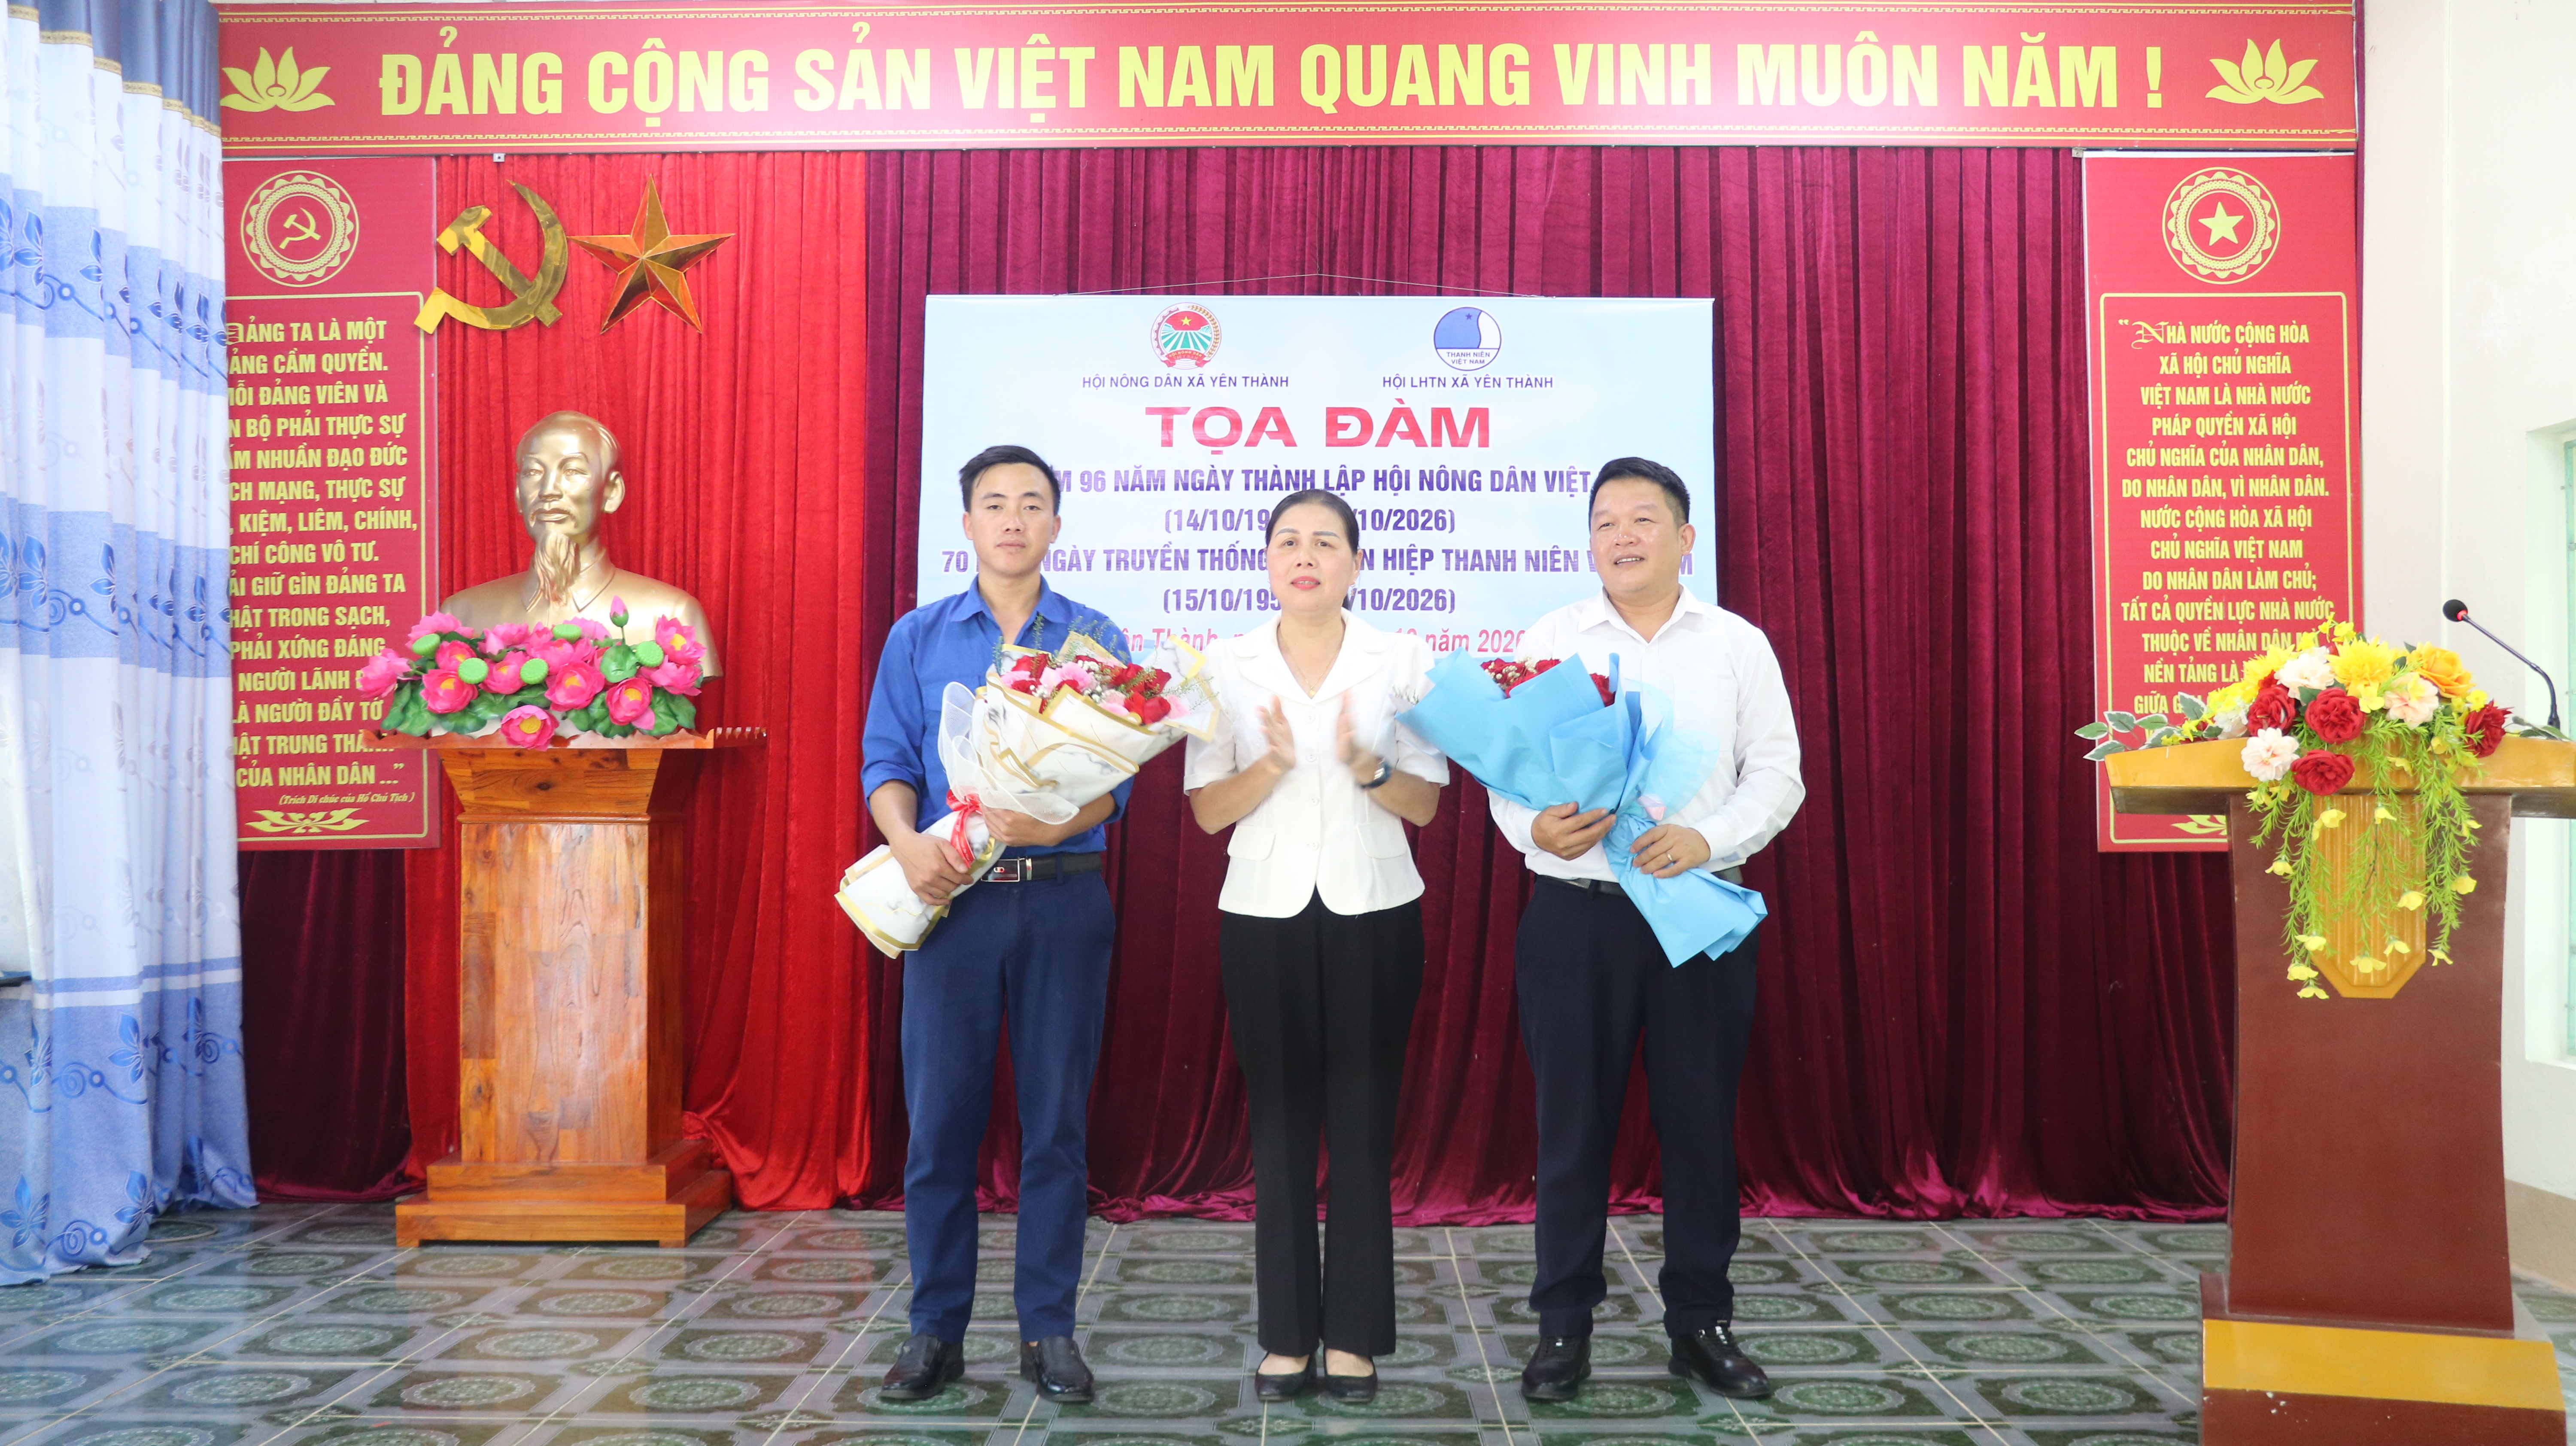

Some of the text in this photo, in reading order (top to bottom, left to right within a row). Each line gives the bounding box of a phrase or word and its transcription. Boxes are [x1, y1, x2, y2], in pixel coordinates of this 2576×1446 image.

[378, 22, 2163, 127] ĐẢNG CỘNG SẢN VIỆT NAM QUANG VINH MUÔN NĂM !
[289, 316, 387, 344] TA LÀ MỘT
[2190, 319, 2310, 348] NƯỚC CỘNG HÒA
[273, 345, 388, 374] CẦM QUYỀN.
[2159, 347, 2292, 378] XÃ HỘI CHỦ NGHĨA
[258, 378, 388, 405] ĐẢNG VIÊN VÀ
[1083, 373, 1288, 391] HỘI NÔNG DÂN XÃ YÊN THÀNH
[1383, 373, 1553, 390] HỘI LHTN XÃ YÊN THÀNH
[2140, 380, 2311, 409] VIỆT NAM LÀ NHÀ NƯỚC
[246, 414, 271, 441] BỘ
[276, 409, 320, 437] PHẢI
[325, 414, 374, 439] THỰC
[379, 413, 407, 438] SỰ
[1145, 398, 1489, 455] TỌA ĐÀM
[2152, 410, 2297, 439] PHÁP QUYỀN XÃ HỘI
[256, 442, 322, 469] NHUẦN
[326, 447, 365, 471] ĐẠO
[369, 441, 407, 466] ĐỨC
[2126, 440, 2324, 468] CHỦ NGHĨA CỦA NHÂN DÂN,
[258, 476, 407, 504] MẠNG, THỰC SỰ
[1080, 470, 1106, 492] 96
[1114, 465, 1166, 492] NĂM
[1174, 464, 1234, 492] NGÀY
[1242, 464, 1315, 491] THÀNH
[1324, 465, 1365, 496] LẬP
[1373, 464, 1410, 496] HỘI
[1419, 464, 1482, 492] NÔNG
[1490, 465, 1536, 492] DÂN
[1543, 466, 1591, 498] VIỆT
[2122, 474, 2330, 499] DO NHÂN DÂN, VÌ NHÂN DÂN.
[240, 509, 292, 536] KIỆM,
[298, 507, 349, 532] LIÊM,
[354, 506, 417, 531] CHÍNH,
[1165, 509, 1273, 534] (14/10/19
[2140, 504, 2312, 532] NƯỚC CỘNG HÒA XÃ HỘI
[229, 539, 379, 565] CHÍ CÔNG VÔ TƯ.
[942, 550, 968, 572] 70
[1103, 541, 1189, 571] TRUYỀN
[1197, 541, 1268, 571] THỐNG
[1383, 543, 1434, 576] HIỆP
[1441, 549, 1516, 572] THANH
[1525, 545, 1579, 572] NIÊN
[2151, 532, 2303, 563] CHỦ NGHĨA VIỆT NAM
[252, 566, 406, 596] GIỮ GÌN ĐẢNG TA
[2142, 562, 2317, 591] DO NHÂN DÂN LÀM CHỦ;
[1163, 588, 1282, 613] (15/10/195
[2121, 594, 2334, 624] TẤT CẢ QUYỀN LỰC NHÀ NƯỚC
[267, 605, 390, 629] TRONG SẠCH,
[278, 634, 386, 659] XỨNG ĐÁNG
[1425, 628, 1469, 652] năm
[2142, 626, 2257, 656] THUỘC VỀ NHÂN
[238, 666, 295, 692] NGƯỜI
[301, 667, 350, 690] LÃNH
[2144, 656, 2240, 683] NỀN TẢNG LÀ
[255, 698, 312, 723] NGƯỜI
[359, 697, 384, 720] TỚ
[2134, 690, 2169, 714] GIỮA
[266, 734, 328, 754] TRUNG
[236, 759, 375, 787] CỦA NHÂN DÂN
[319, 794, 339, 803] chúc
